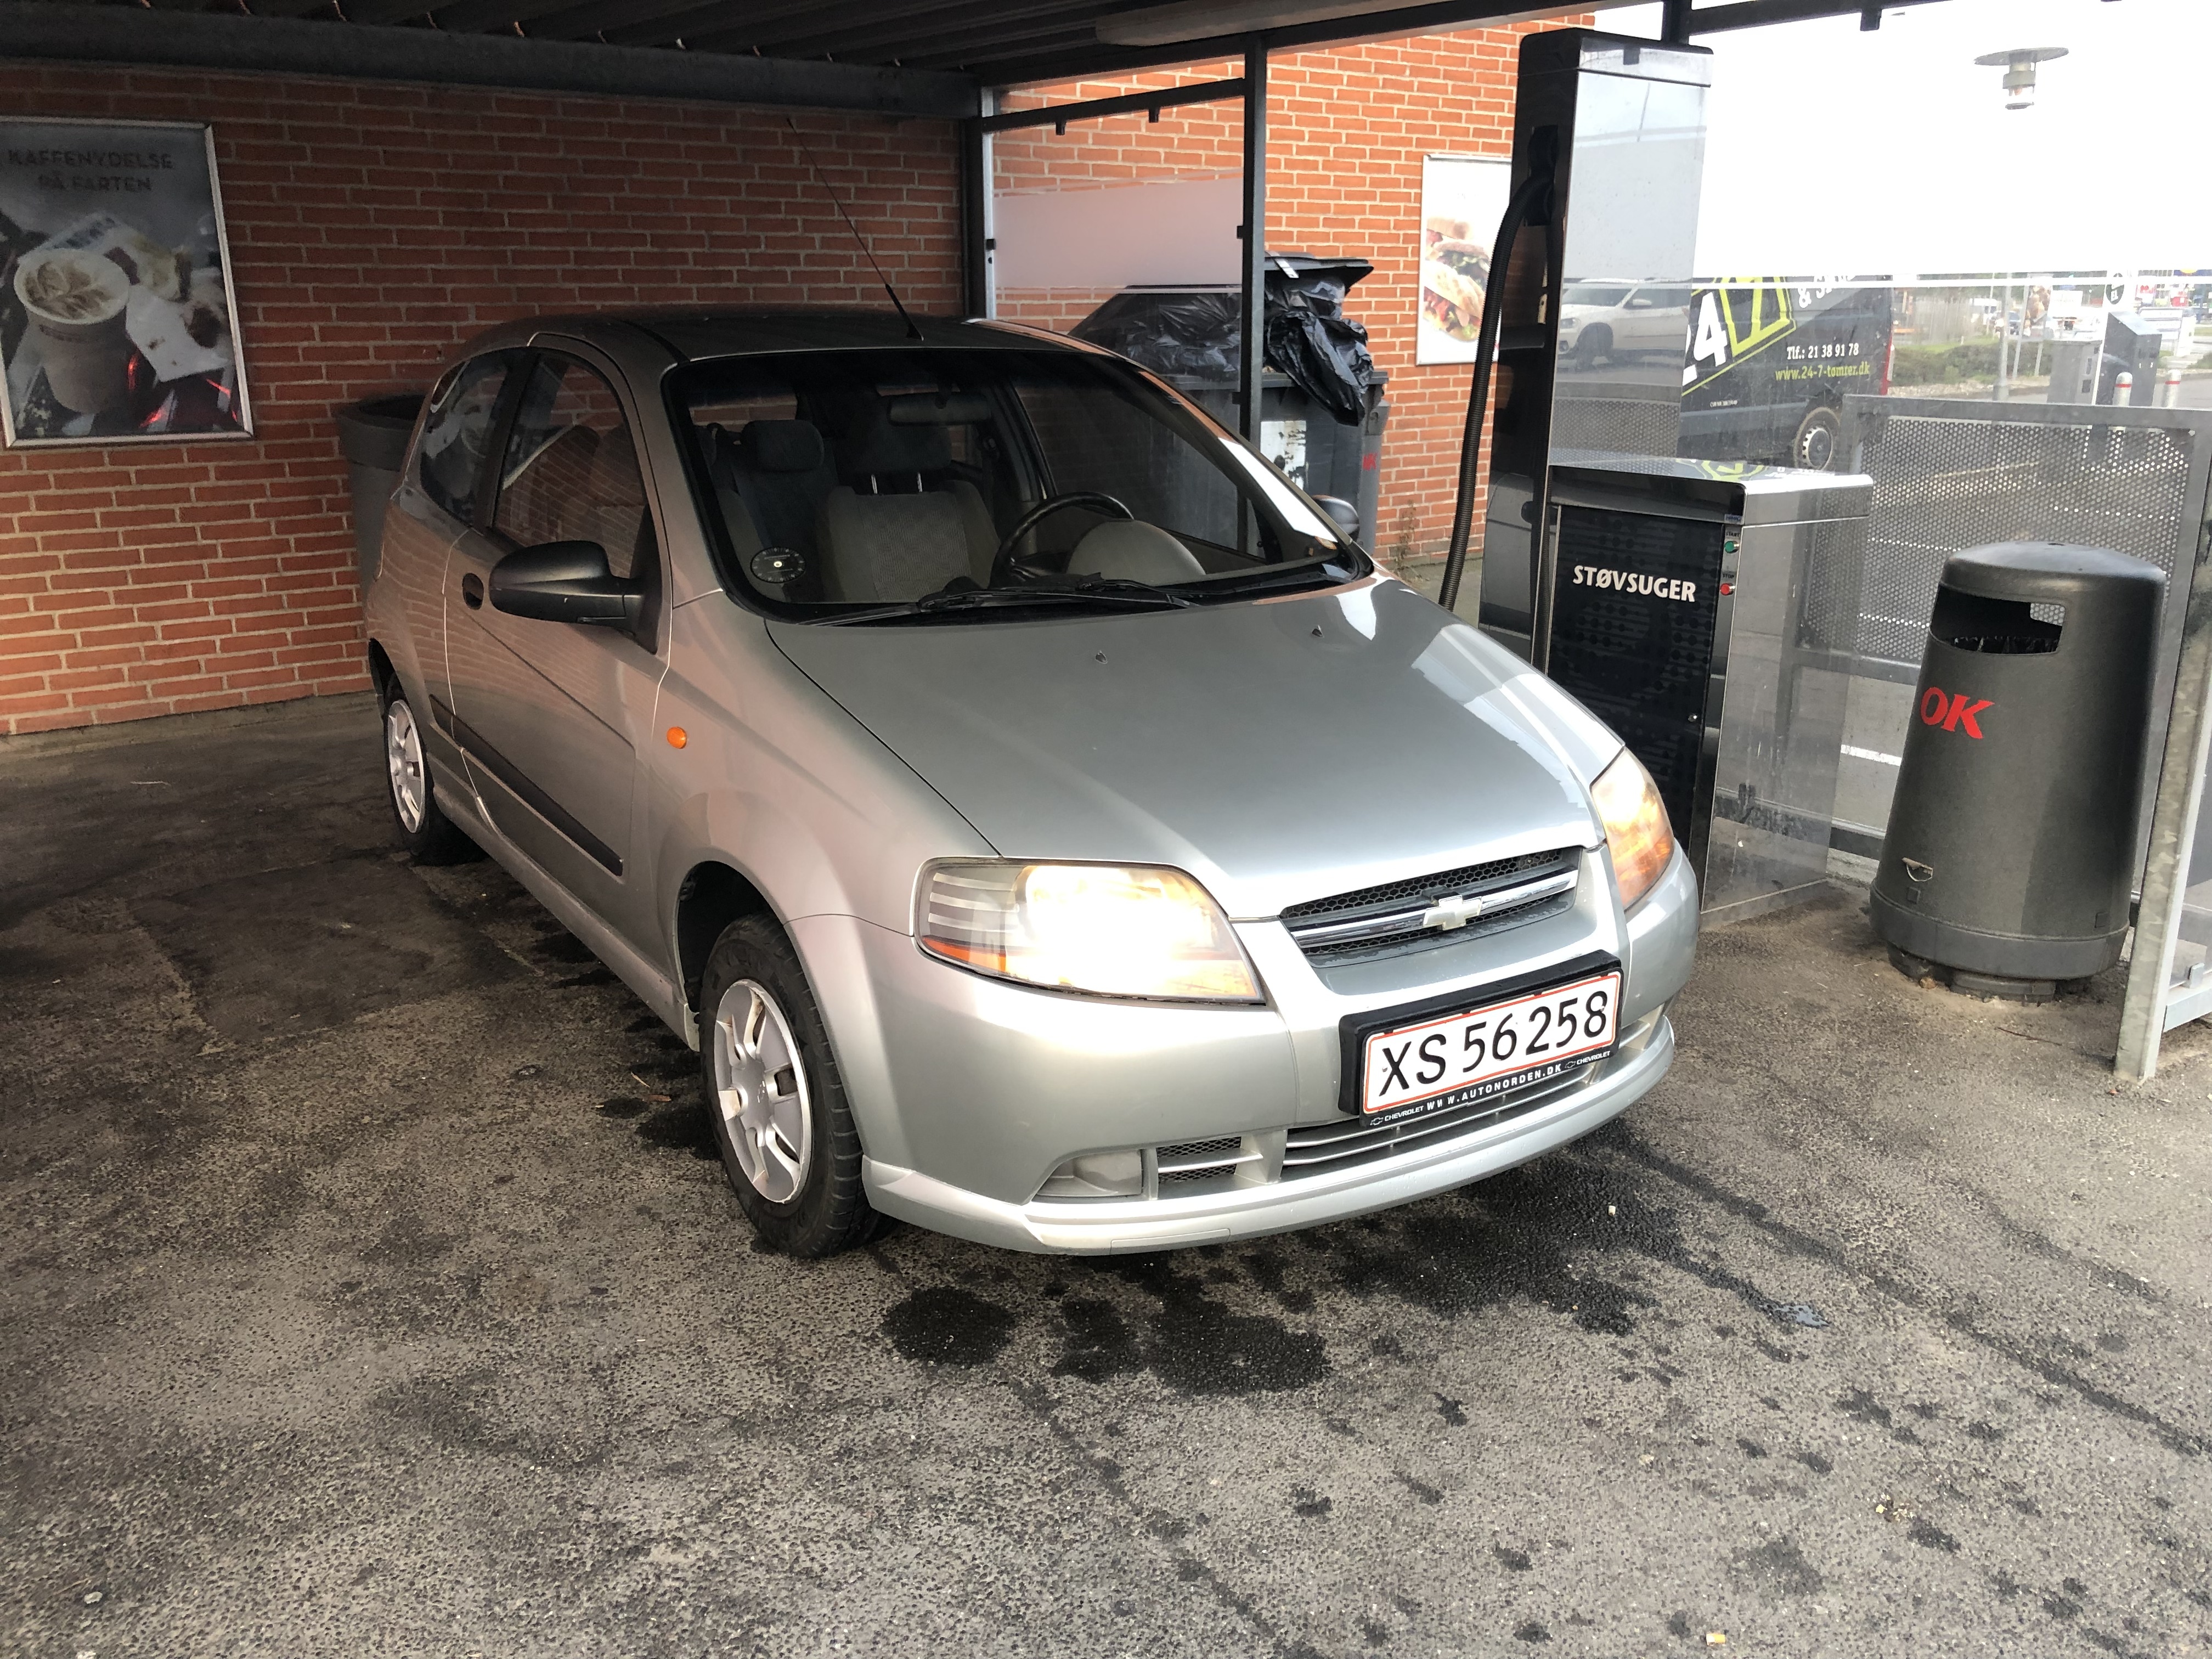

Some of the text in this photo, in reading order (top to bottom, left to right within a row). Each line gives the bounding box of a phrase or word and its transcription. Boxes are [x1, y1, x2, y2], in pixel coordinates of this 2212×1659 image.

[8, 148, 174, 170] KAFFENYDELSE
[72, 175, 153, 192] FARTEN
[1808, 346, 1818, 359] 21
[1821, 343, 1832, 358] 38
[1835, 343, 1846, 357] 91
[1848, 342, 1859, 356] 78
[1572, 565, 1696, 602] STØVSUGER
[1921, 686, 1995, 740] OK
[1379, 1034, 1447, 1097] XS
[1384, 1105, 1424, 1122] CHEVROLET
[1576, 1050, 1611, 1065] CHEVROLET
